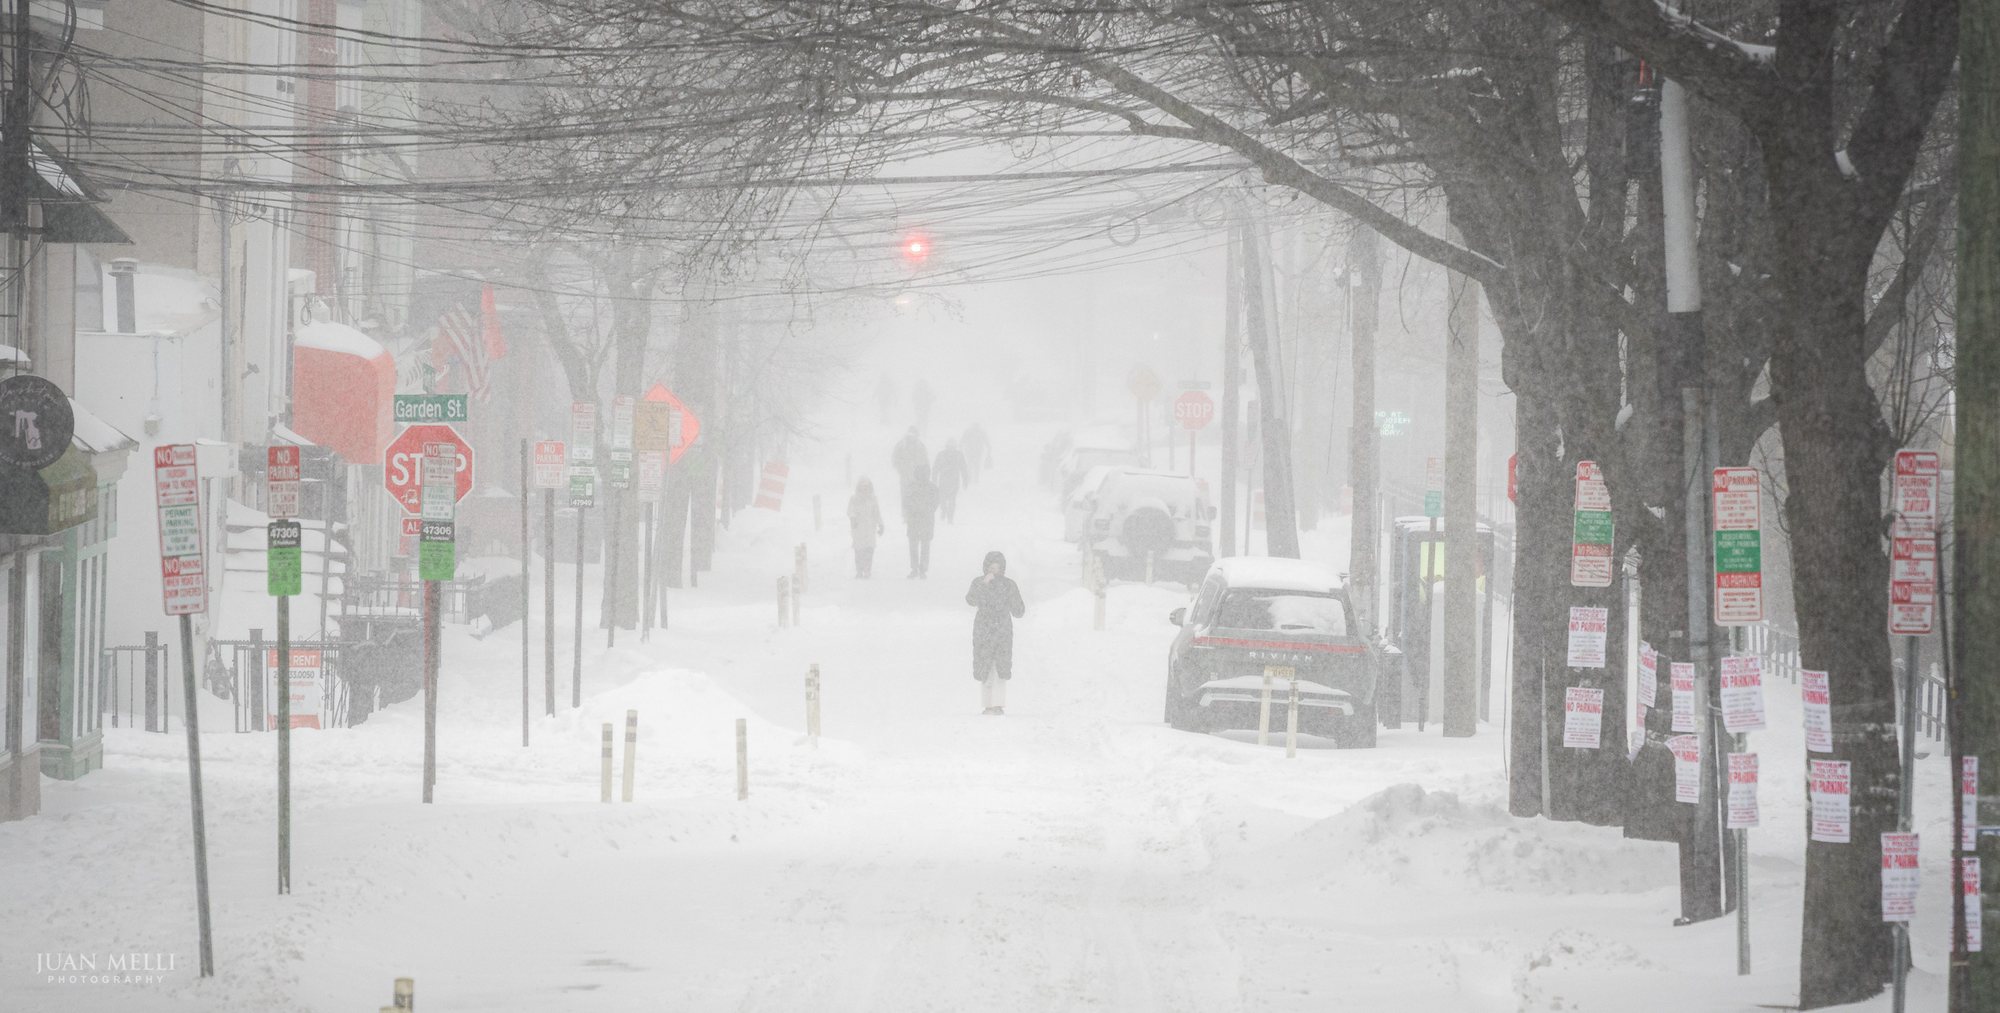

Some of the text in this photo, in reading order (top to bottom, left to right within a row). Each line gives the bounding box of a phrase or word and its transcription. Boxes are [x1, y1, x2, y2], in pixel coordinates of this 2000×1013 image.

[396, 400, 464, 418] Garden St.
[1176, 402, 1211, 418] STOP
[426, 445, 438, 457] NO
[544, 443, 556, 454] NO
[157, 448, 173, 465] NO
[276, 449, 290, 464] NO
[536, 455, 563, 464] PARKING
[1899, 455, 1937, 474] NO PARKING
[269, 465, 300, 479] PARKING
[1715, 474, 1760, 488] NO PARKING
[1900, 477, 1932, 488] DURING
[165, 509, 192, 518] PERMIT
[166, 519, 195, 528] PARKING
[270, 527, 298, 538] 47306
[423, 526, 452, 535] 47306
[1895, 541, 1935, 558] NO PARKING
[164, 558, 179, 575] NO
[1721, 575, 1759, 587] NO PARKING
[1894, 583, 1910, 601] NO
[1570, 621, 1606, 633] NO PARKING
[293, 655, 317, 666] RENT
[1249, 651, 1313, 662] RIVIAN
[1730, 674, 1762, 688] PARKING
[1567, 702, 1602, 714] NO PARKING
[1819, 780, 1849, 795] PARKING
